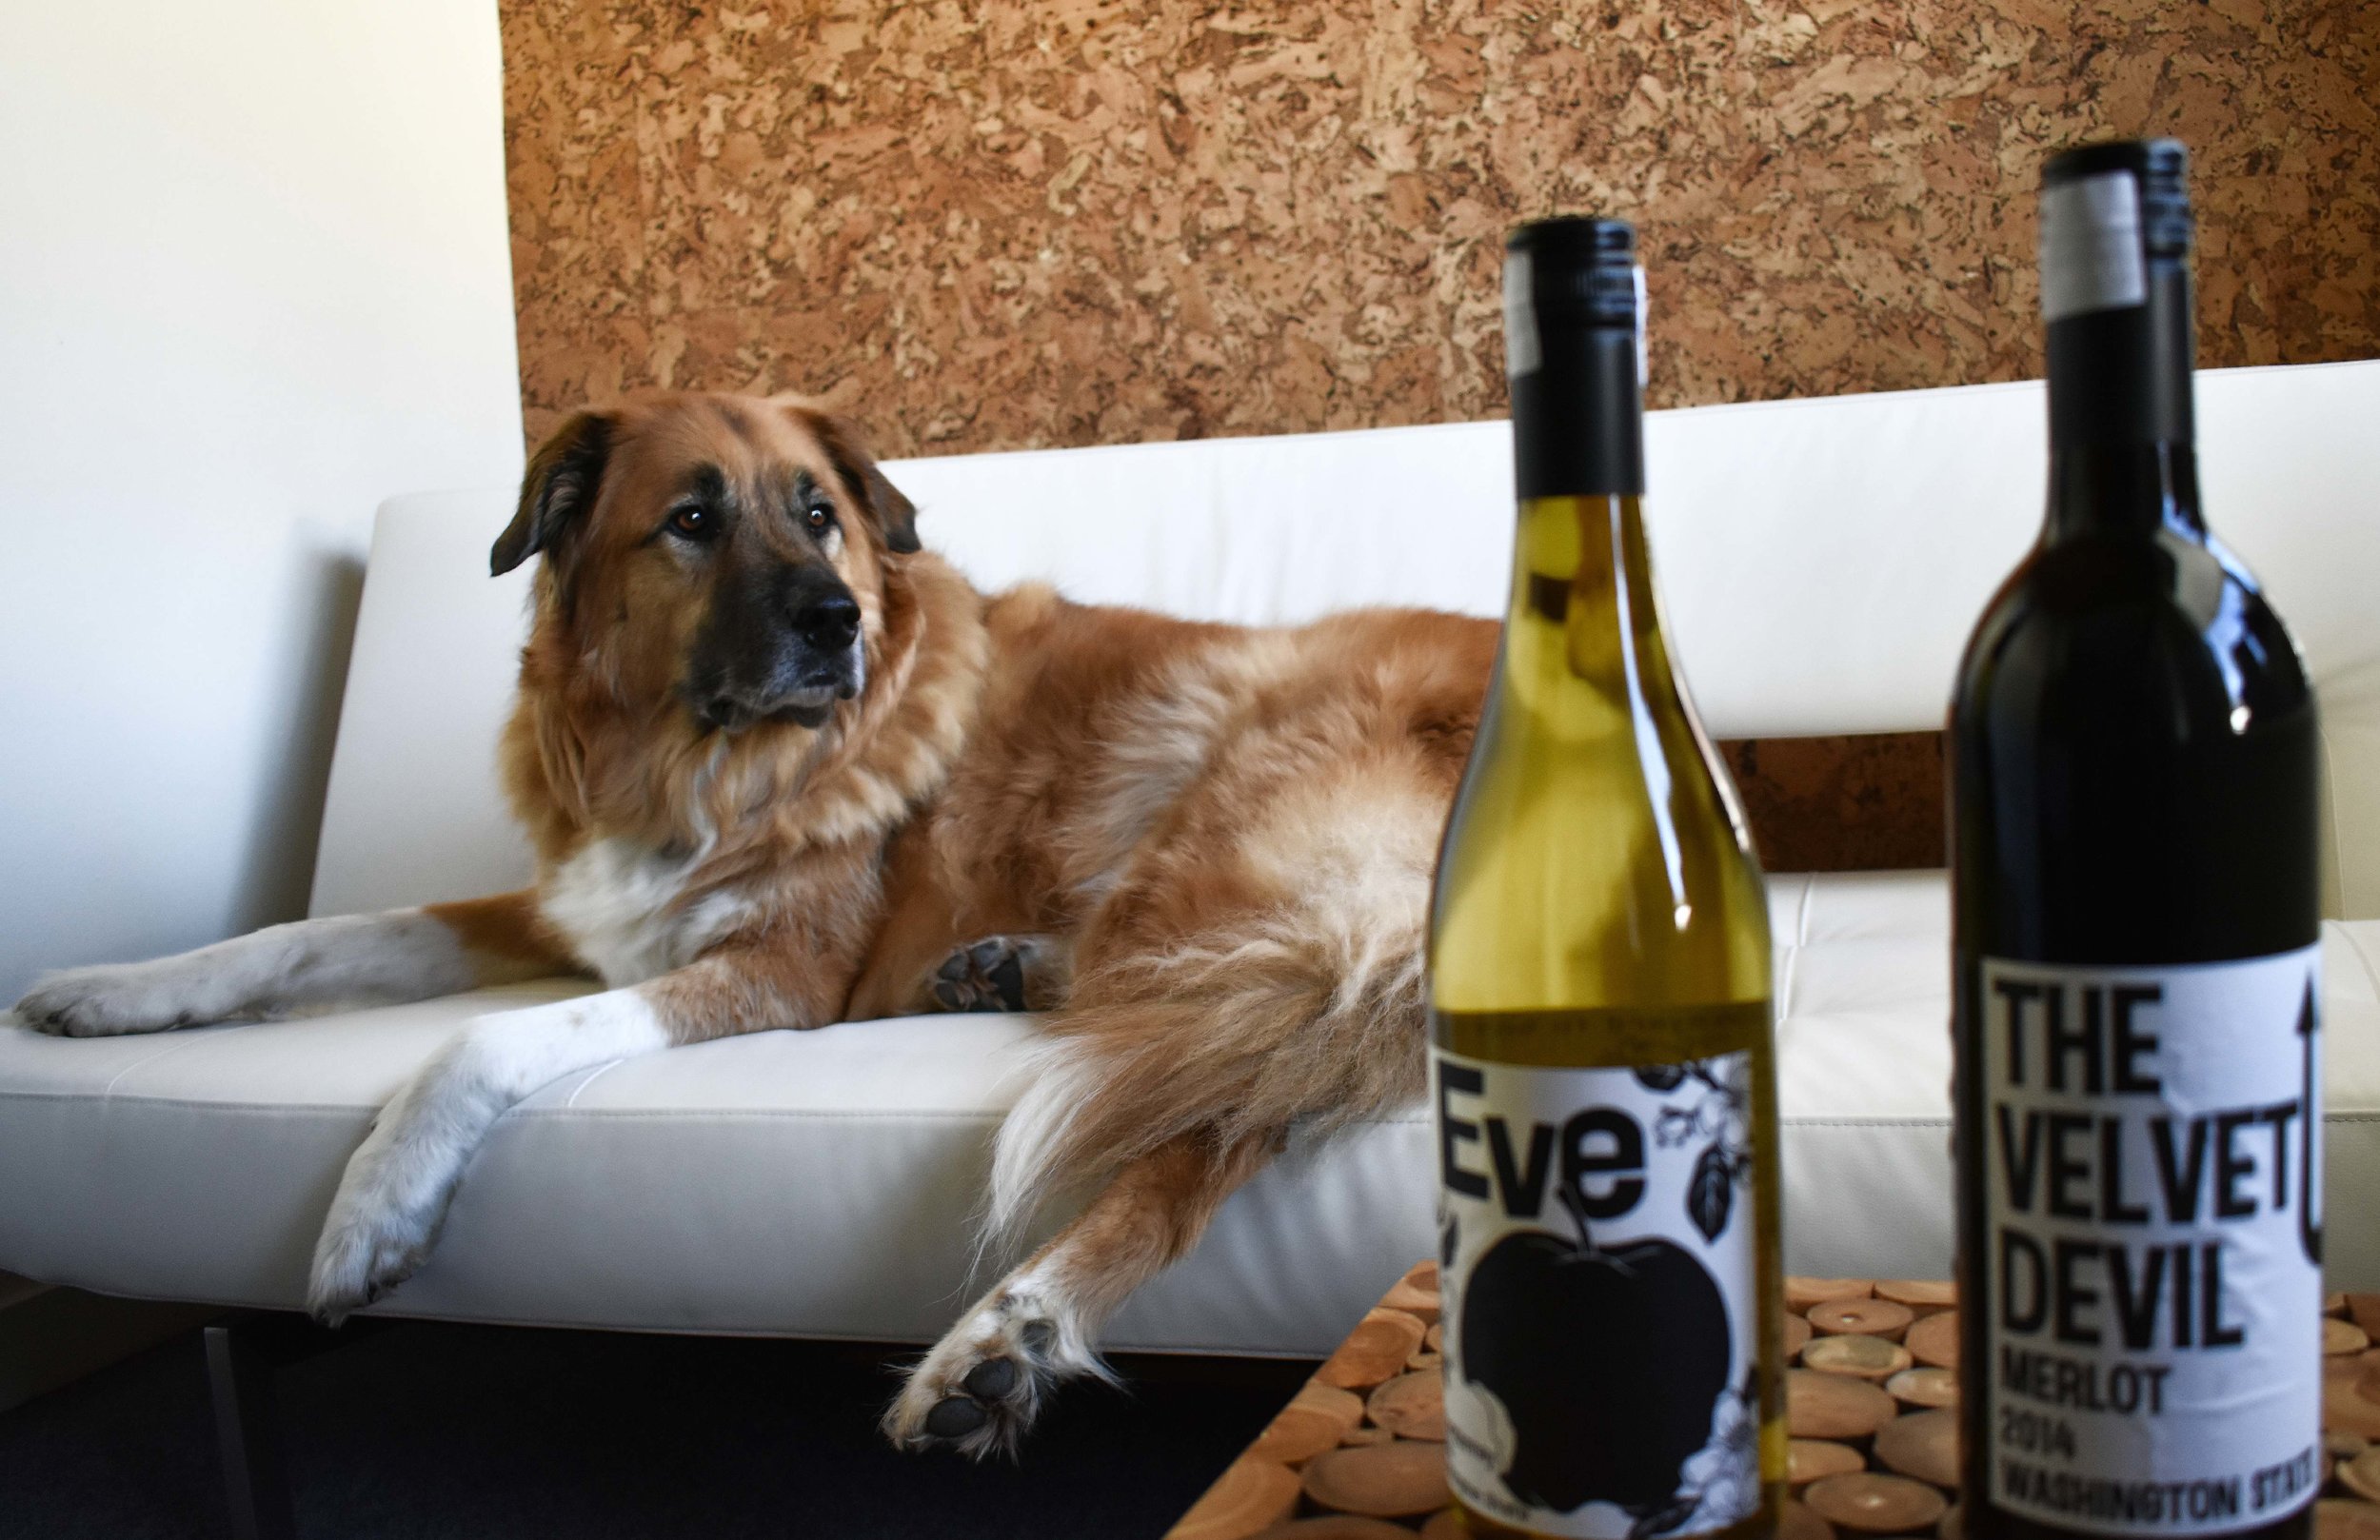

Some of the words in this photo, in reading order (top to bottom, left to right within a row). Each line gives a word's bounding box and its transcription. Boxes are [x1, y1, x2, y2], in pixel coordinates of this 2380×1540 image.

[1994, 978, 2163, 1096] THE
[1438, 1059, 1647, 1220] Eve
[1995, 1098, 2300, 1223] VELVET
[2000, 1231, 2245, 1352] DEVIL
[2002, 1343, 2172, 1415] MERLOT
[2002, 1405, 2076, 1462] 2014
[2002, 1456, 2241, 1523] WASHINGTON
